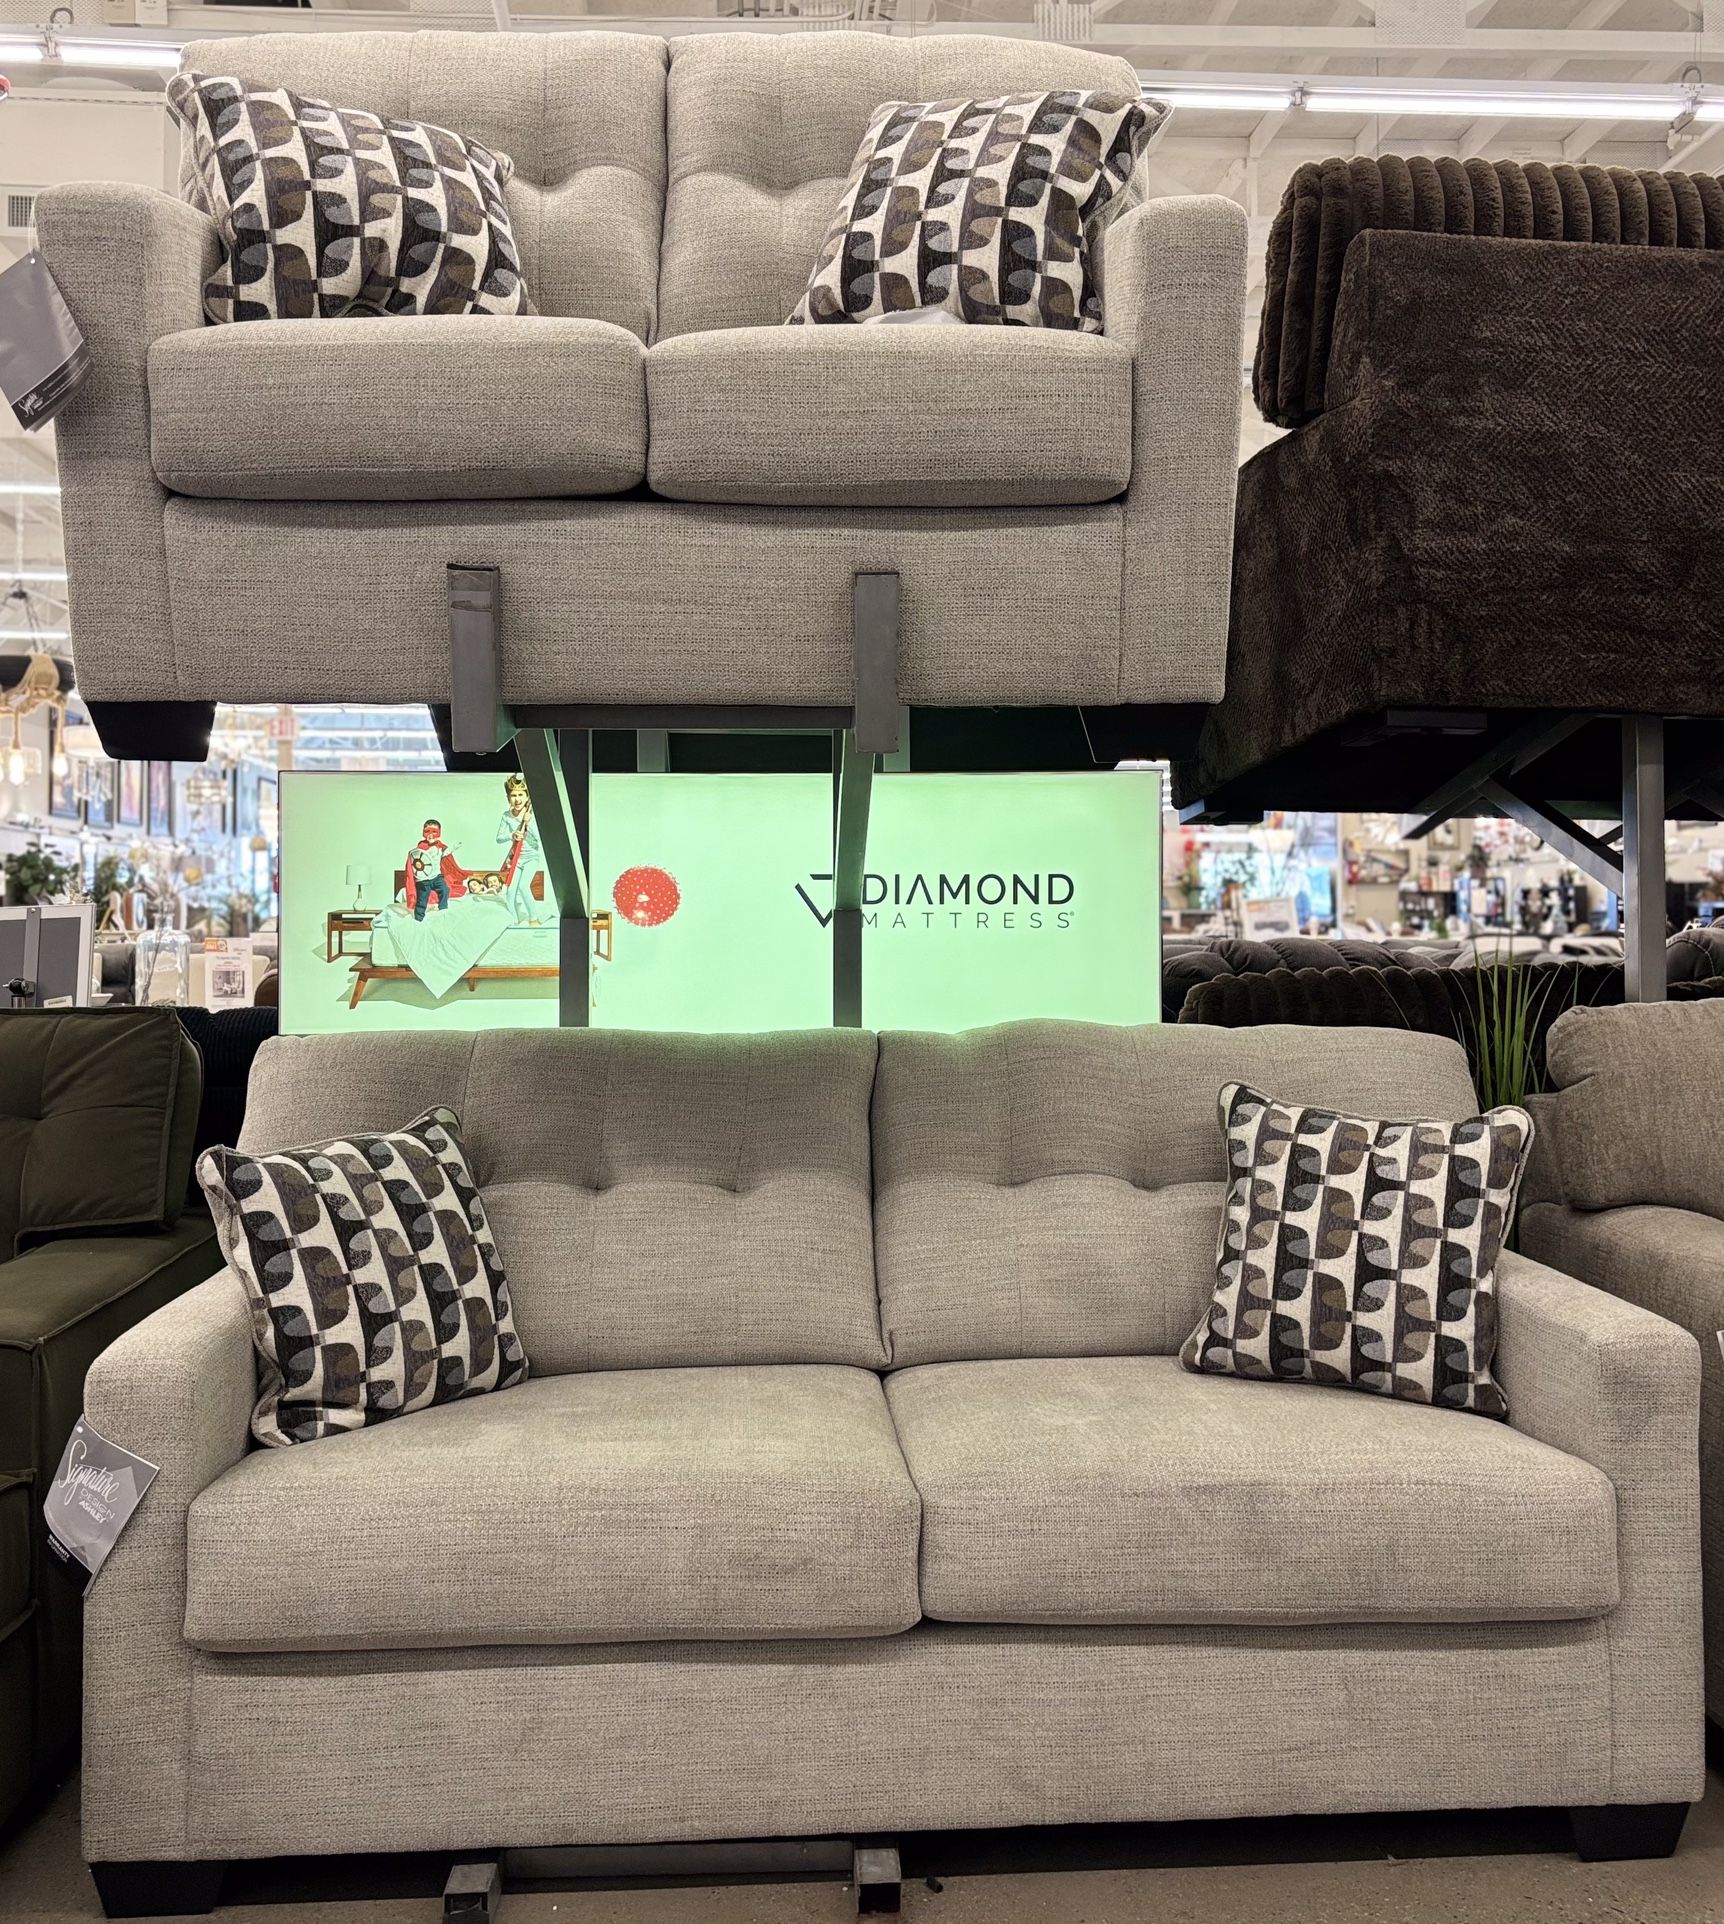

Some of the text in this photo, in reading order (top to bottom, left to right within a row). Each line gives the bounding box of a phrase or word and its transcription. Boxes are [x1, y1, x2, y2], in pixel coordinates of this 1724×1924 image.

[862, 873, 1075, 905] DIAMOND
[58, 1439, 120, 1506] Signature
[78, 1500, 108, 1524] ASHLEY
[80, 1487, 116, 1519] DESIGN
